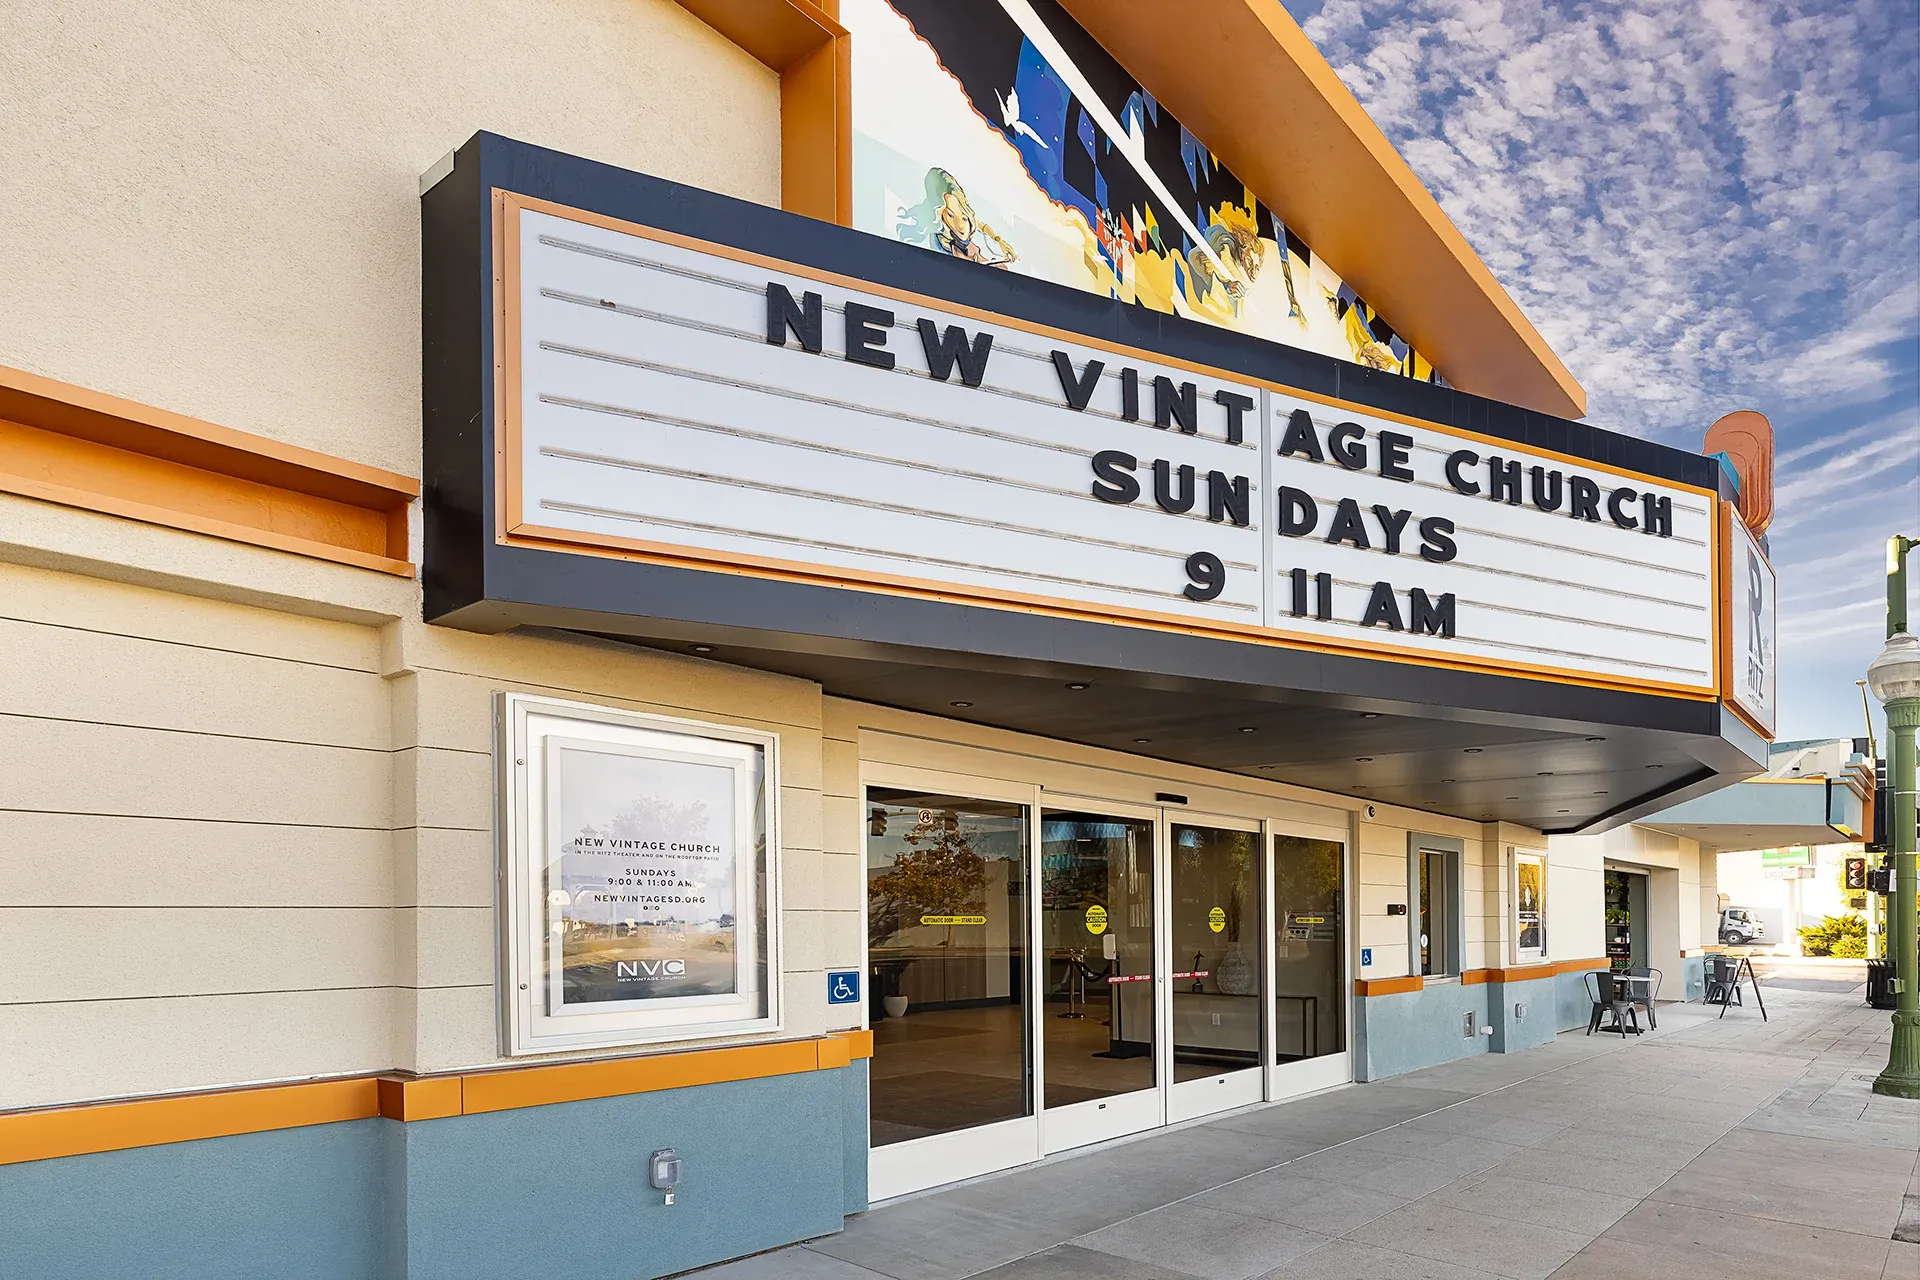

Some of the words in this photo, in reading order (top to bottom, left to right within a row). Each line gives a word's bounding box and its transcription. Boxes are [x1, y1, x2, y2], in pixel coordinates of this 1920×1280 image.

[766, 282, 994, 387] NEW
[1050, 350, 1415, 483] VINTAGE
[1446, 450, 1673, 538] CHURCH
[1092, 450, 1458, 562] SUNDAYS
[1184, 551, 1226, 602] 9
[1293, 568, 1332, 620] 11
[1362, 582, 1456, 639] AM
[1747, 545, 1763, 666] R
[1747, 655, 1764, 699] RITZ
[574, 837, 604, 847] NEW
[609, 839, 666, 851] VINTAGE
[670, 842, 720, 853] CHURCH
[607, 877, 632, 886] 9:00
[647, 879, 674, 887] 11:00
[625, 868, 676, 877] SUNDAYS
[594, 894, 706, 904] NEWVINTAGESD.ORG
[617, 960, 685, 976] NVC
